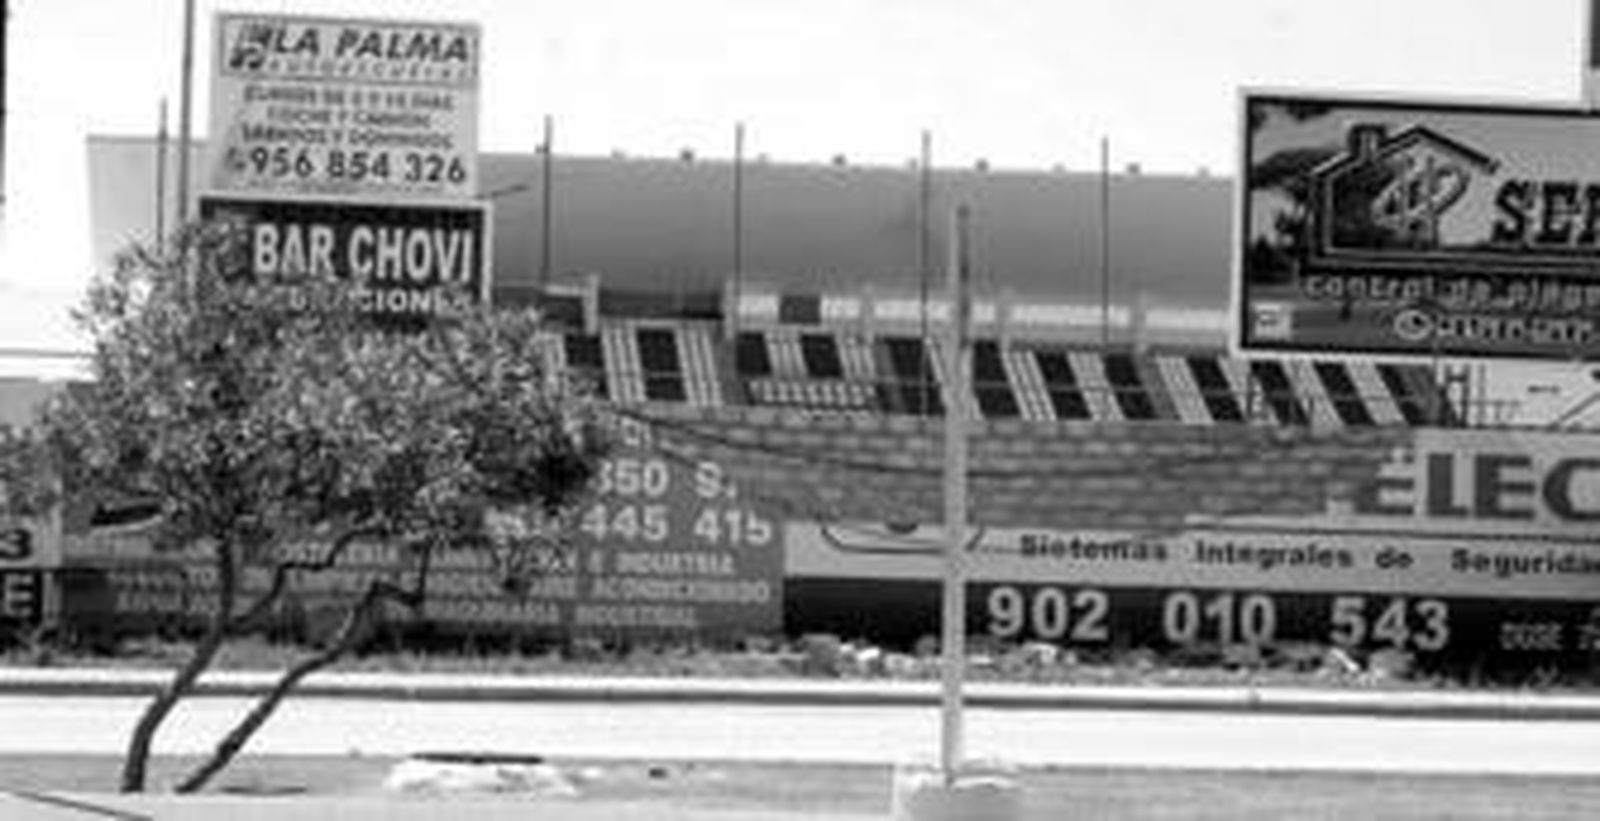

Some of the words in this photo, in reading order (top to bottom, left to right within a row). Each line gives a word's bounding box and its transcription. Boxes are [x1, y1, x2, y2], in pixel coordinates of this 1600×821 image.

[274, 28, 319, 55] LA
[334, 28, 468, 63] PALMA
[251, 147, 313, 179] 956
[327, 151, 390, 181] 854
[403, 153, 466, 184] 326
[253, 222, 335, 277] BAR
[349, 225, 473, 281] CHOVI
[580, 503, 669, 542] 445
[693, 508, 773, 546] 415
[1197, 541, 1352, 570] Integrales
[989, 587, 1109, 641] 902
[1163, 594, 1275, 646] 010
[1328, 597, 1450, 650] 543
